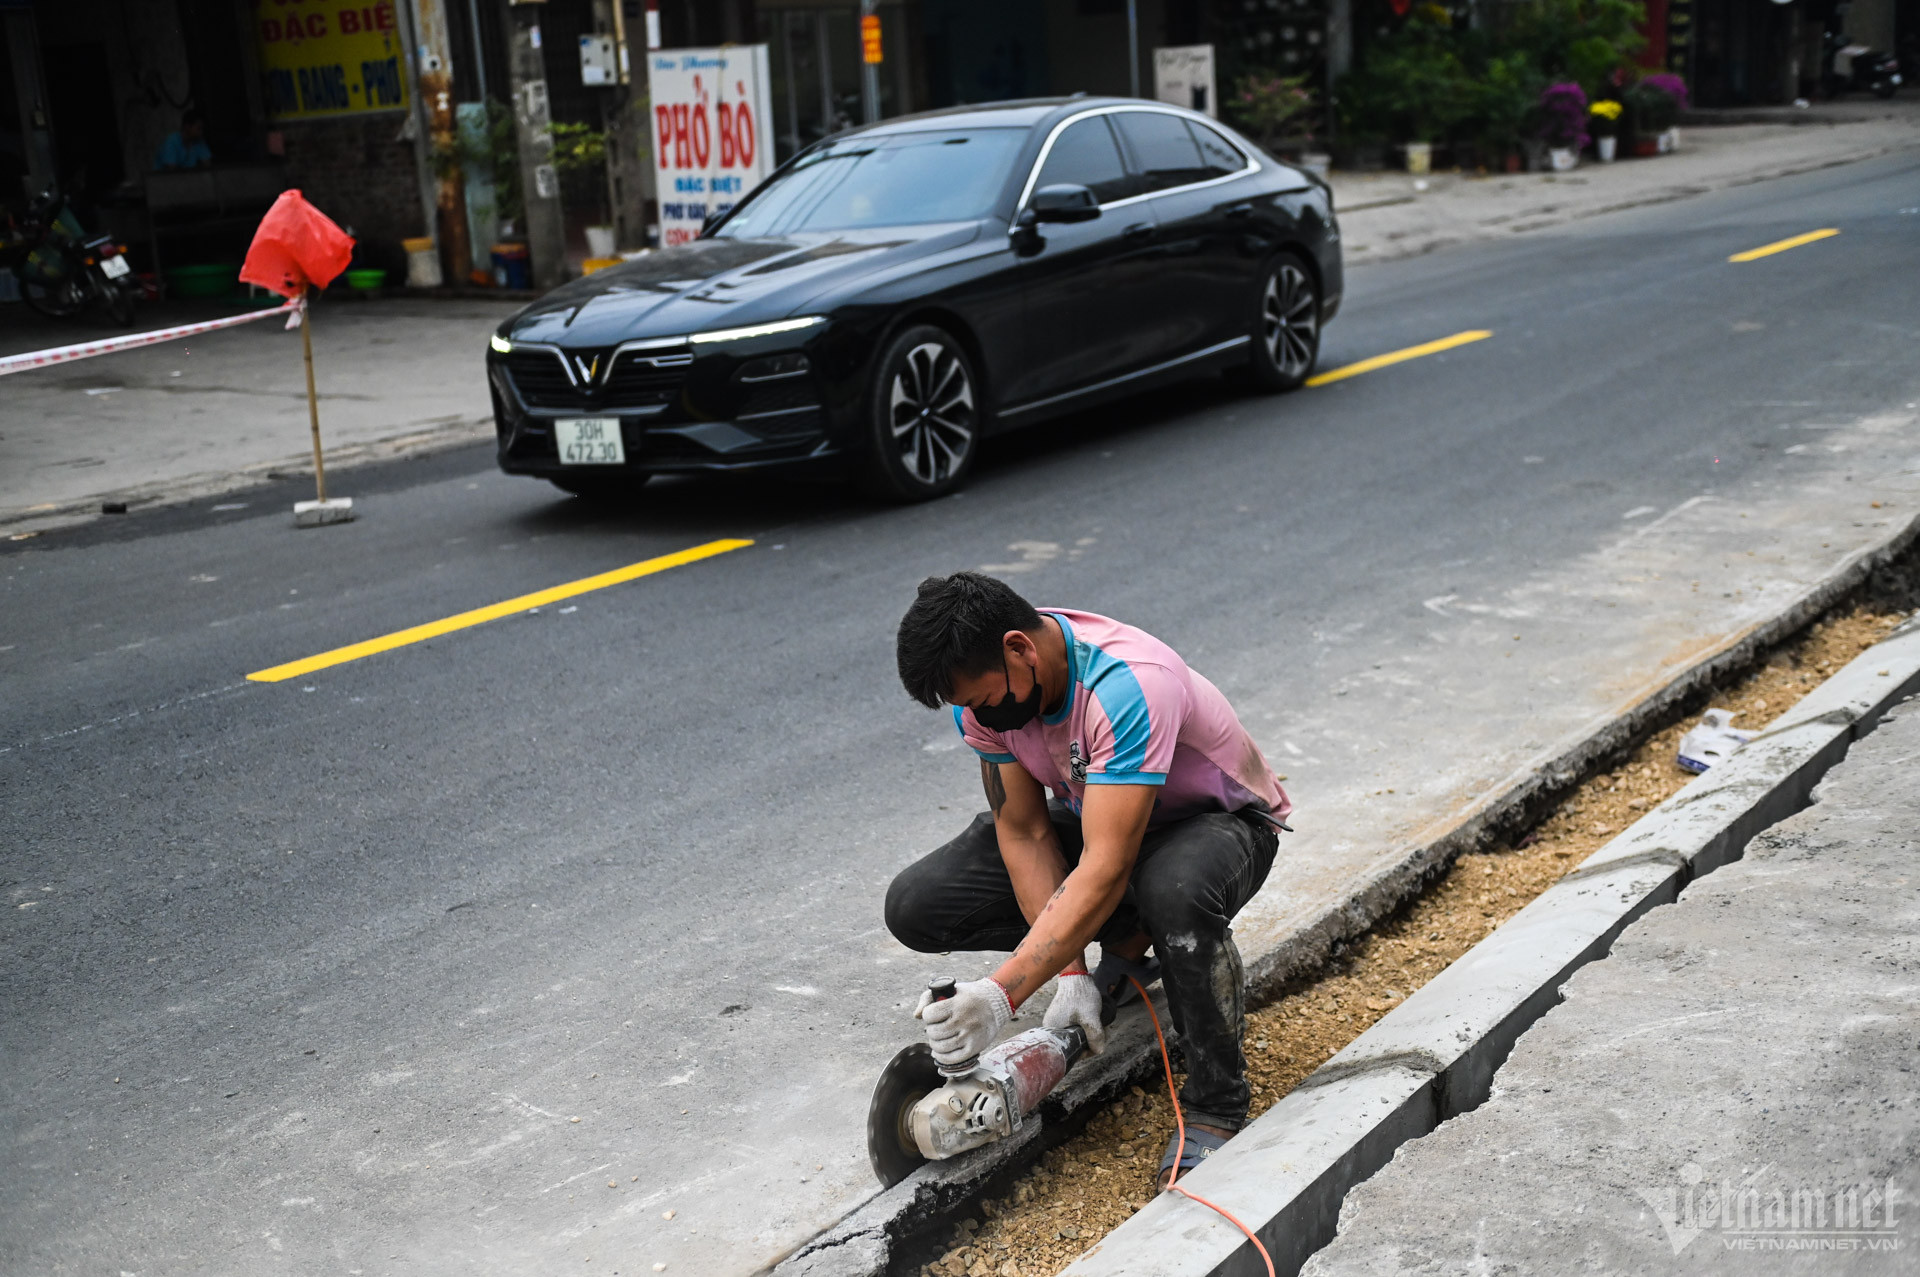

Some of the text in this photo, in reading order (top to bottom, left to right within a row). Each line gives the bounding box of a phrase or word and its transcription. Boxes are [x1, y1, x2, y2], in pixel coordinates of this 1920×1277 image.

[261, 1, 395, 46] ĐẶC BIỆ
[298, 63, 349, 111] RANG
[656, 73, 755, 169] PHỞ BÒ
[566, 441, 617, 462] 472.30
[574, 420, 604, 441] 30H
